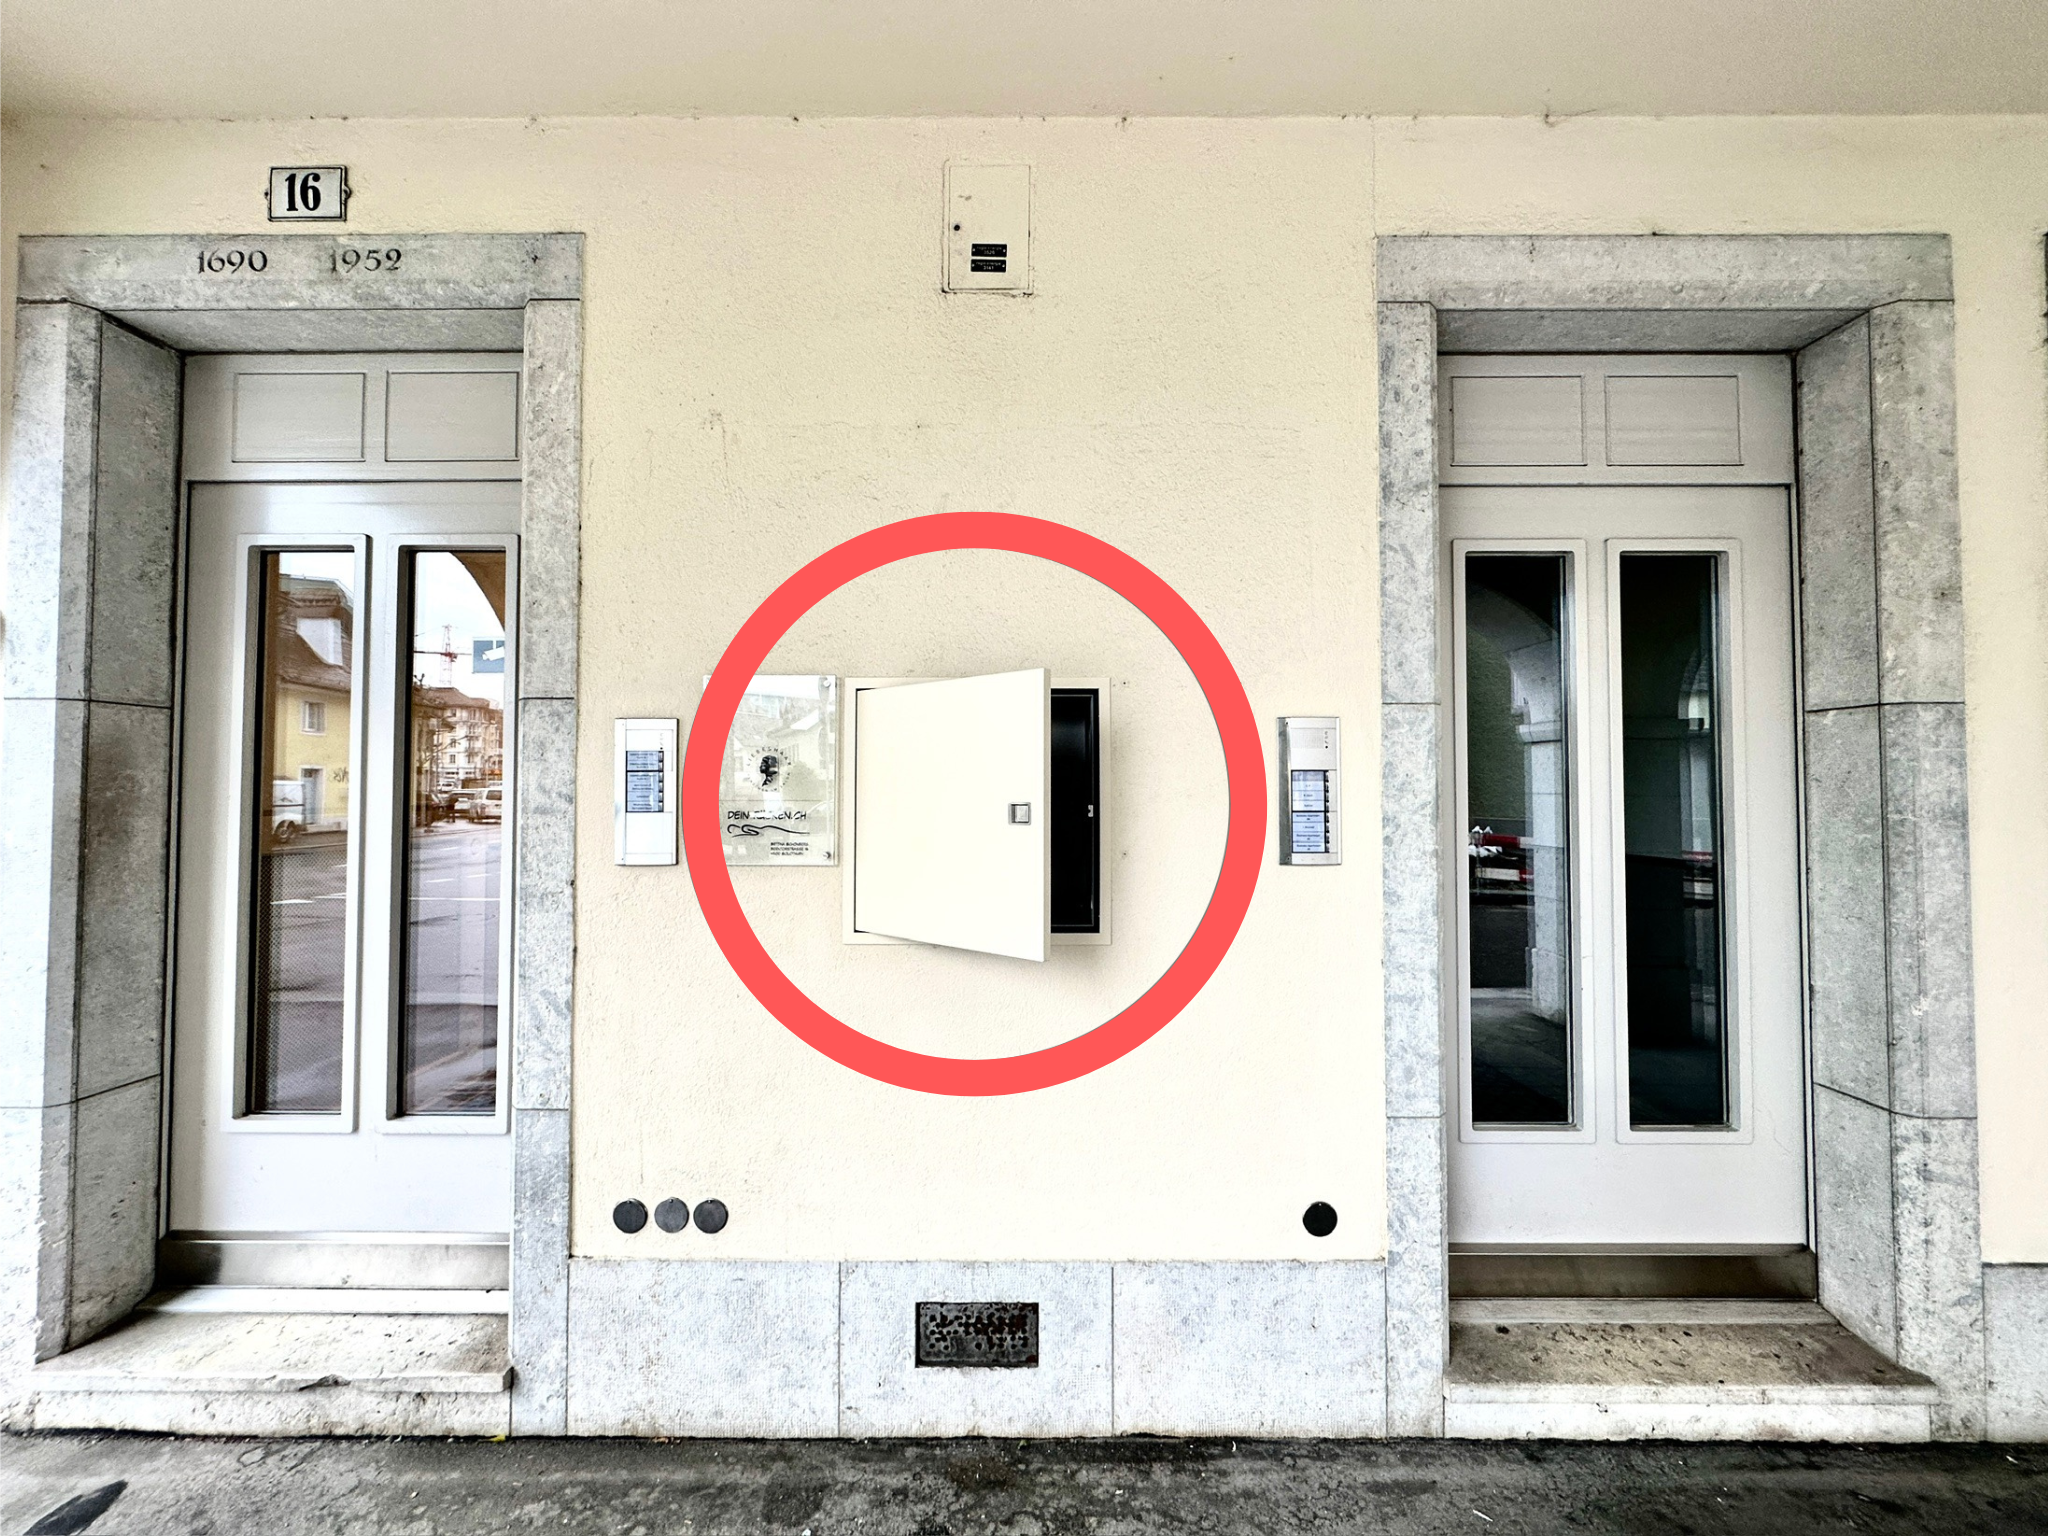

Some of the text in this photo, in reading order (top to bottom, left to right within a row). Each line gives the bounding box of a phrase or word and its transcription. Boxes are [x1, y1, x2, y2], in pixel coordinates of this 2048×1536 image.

[284, 172, 322, 212] 16
[197, 248, 402, 274] 1690 1952
